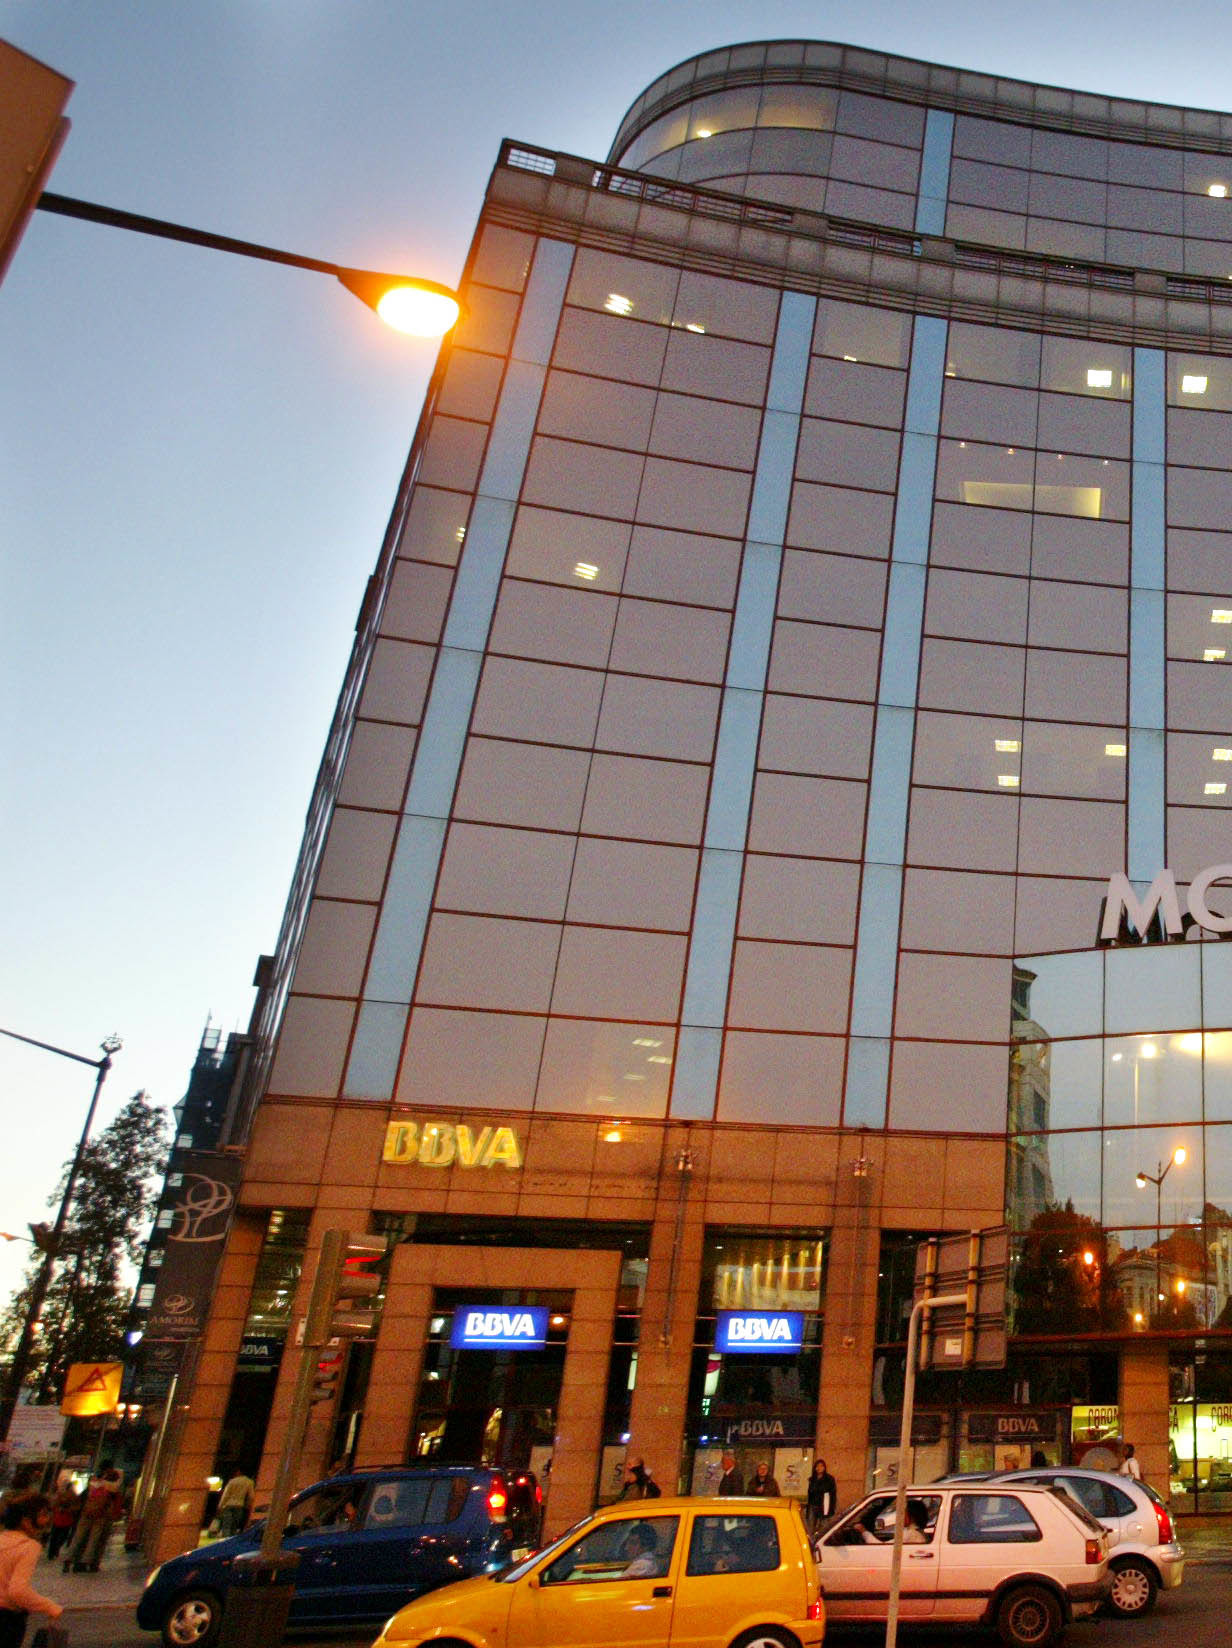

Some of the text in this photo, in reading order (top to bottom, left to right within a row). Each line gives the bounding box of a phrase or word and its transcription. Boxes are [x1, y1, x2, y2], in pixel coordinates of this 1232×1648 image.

[382, 1120, 521, 1169] BBVA
[464, 1312, 535, 1336] BBVA
[728, 1318, 792, 1340] BBVA
[241, 1344, 268, 1355] BVA
[740, 1420, 784, 1435] BBVA
[998, 1417, 1039, 1433] BBVA
